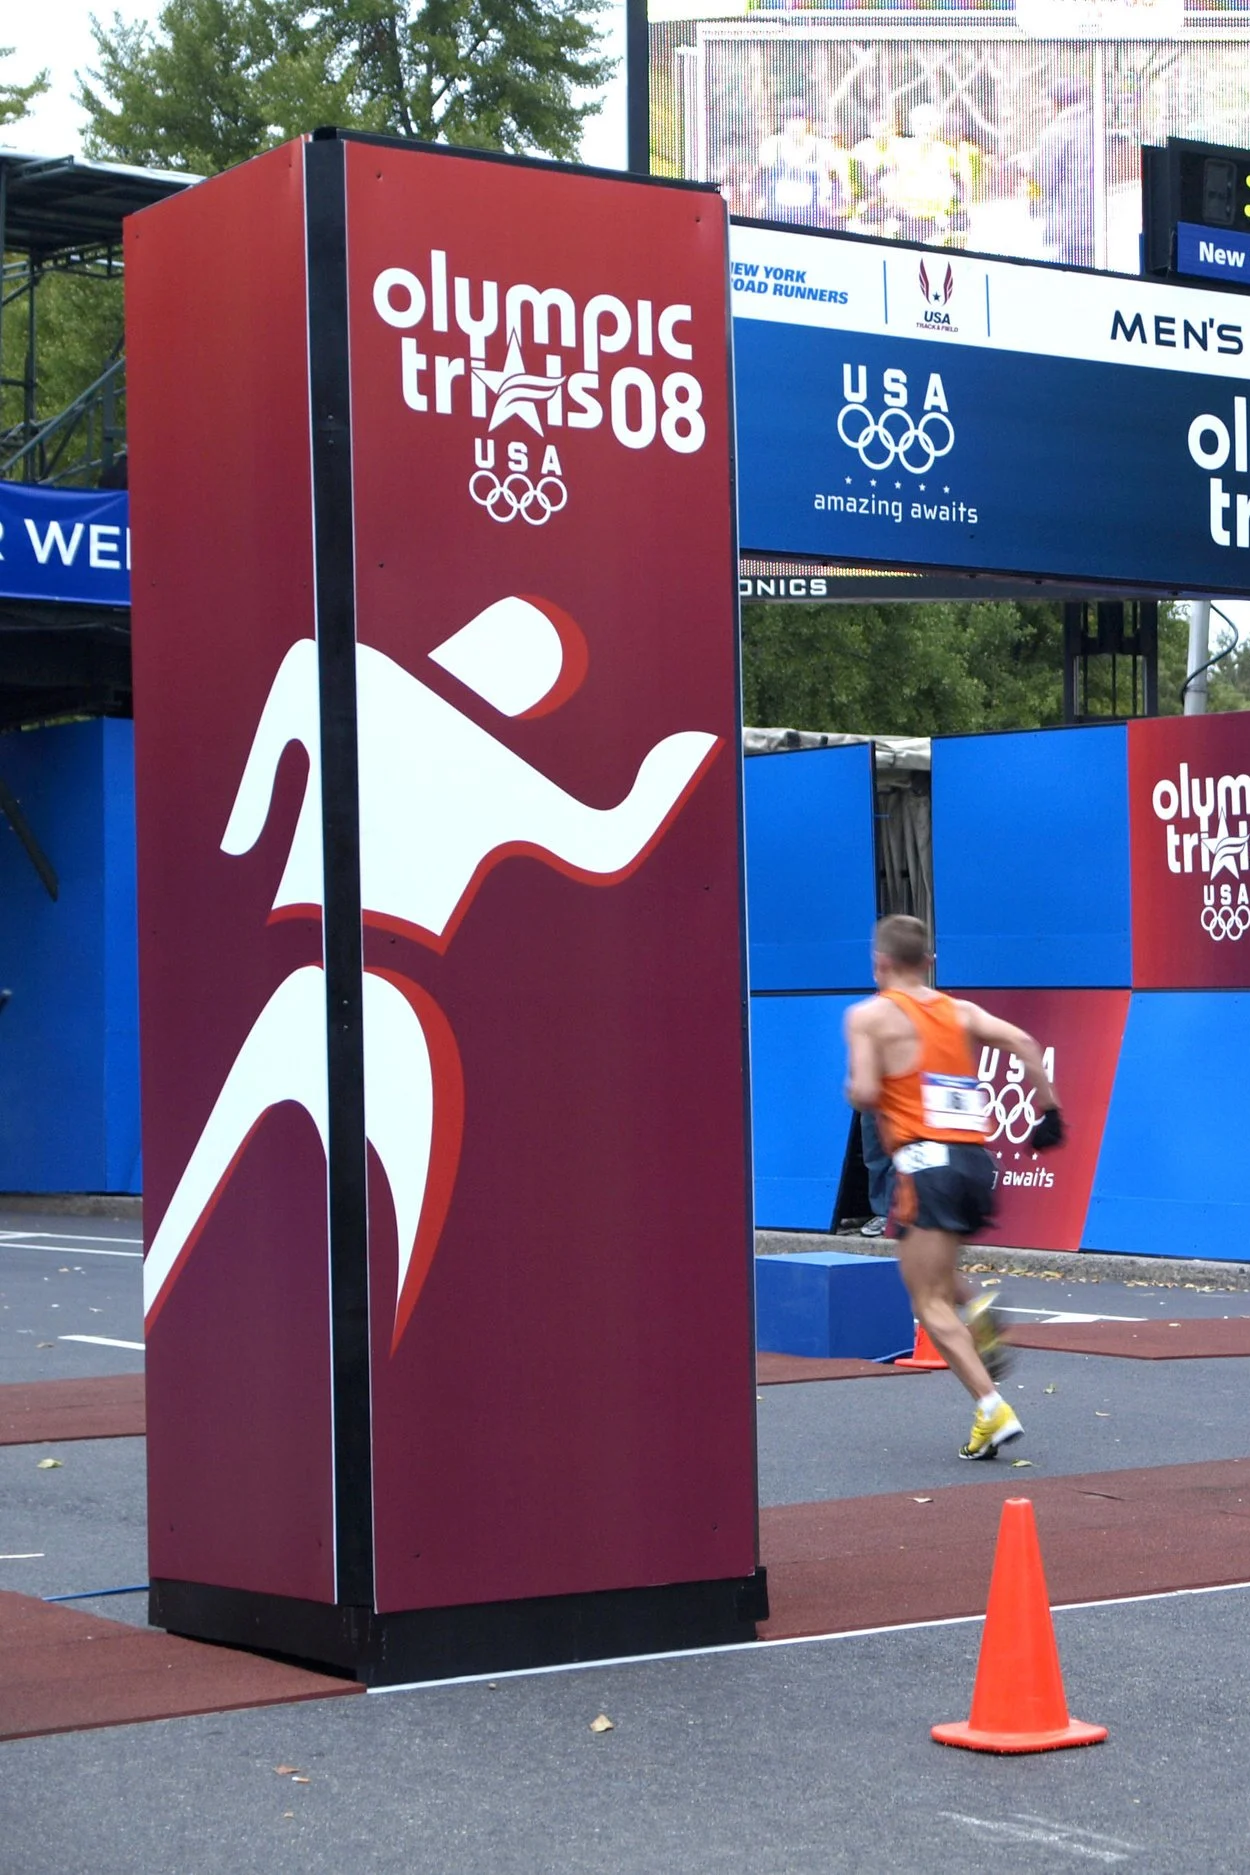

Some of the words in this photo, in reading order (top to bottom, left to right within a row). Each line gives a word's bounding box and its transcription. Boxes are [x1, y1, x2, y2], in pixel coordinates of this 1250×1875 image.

[1199, 241, 1245, 268] New
[764, 266, 807, 284] YORK
[731, 278, 769, 294] OAD
[773, 283, 849, 305] RUNNERS
[373, 248, 693, 372] olympic
[924, 310, 951, 325] USA
[1110, 310, 1244, 355] MEN'S
[842, 363, 949, 413] USA
[474, 437, 562, 476] USA
[814, 493, 903, 523] amazing
[911, 501, 978, 524] awaits
[24, 517, 131, 571] WE
[1203, 883, 1249, 906] USA
[1002, 1167, 1054, 1188] awaits
